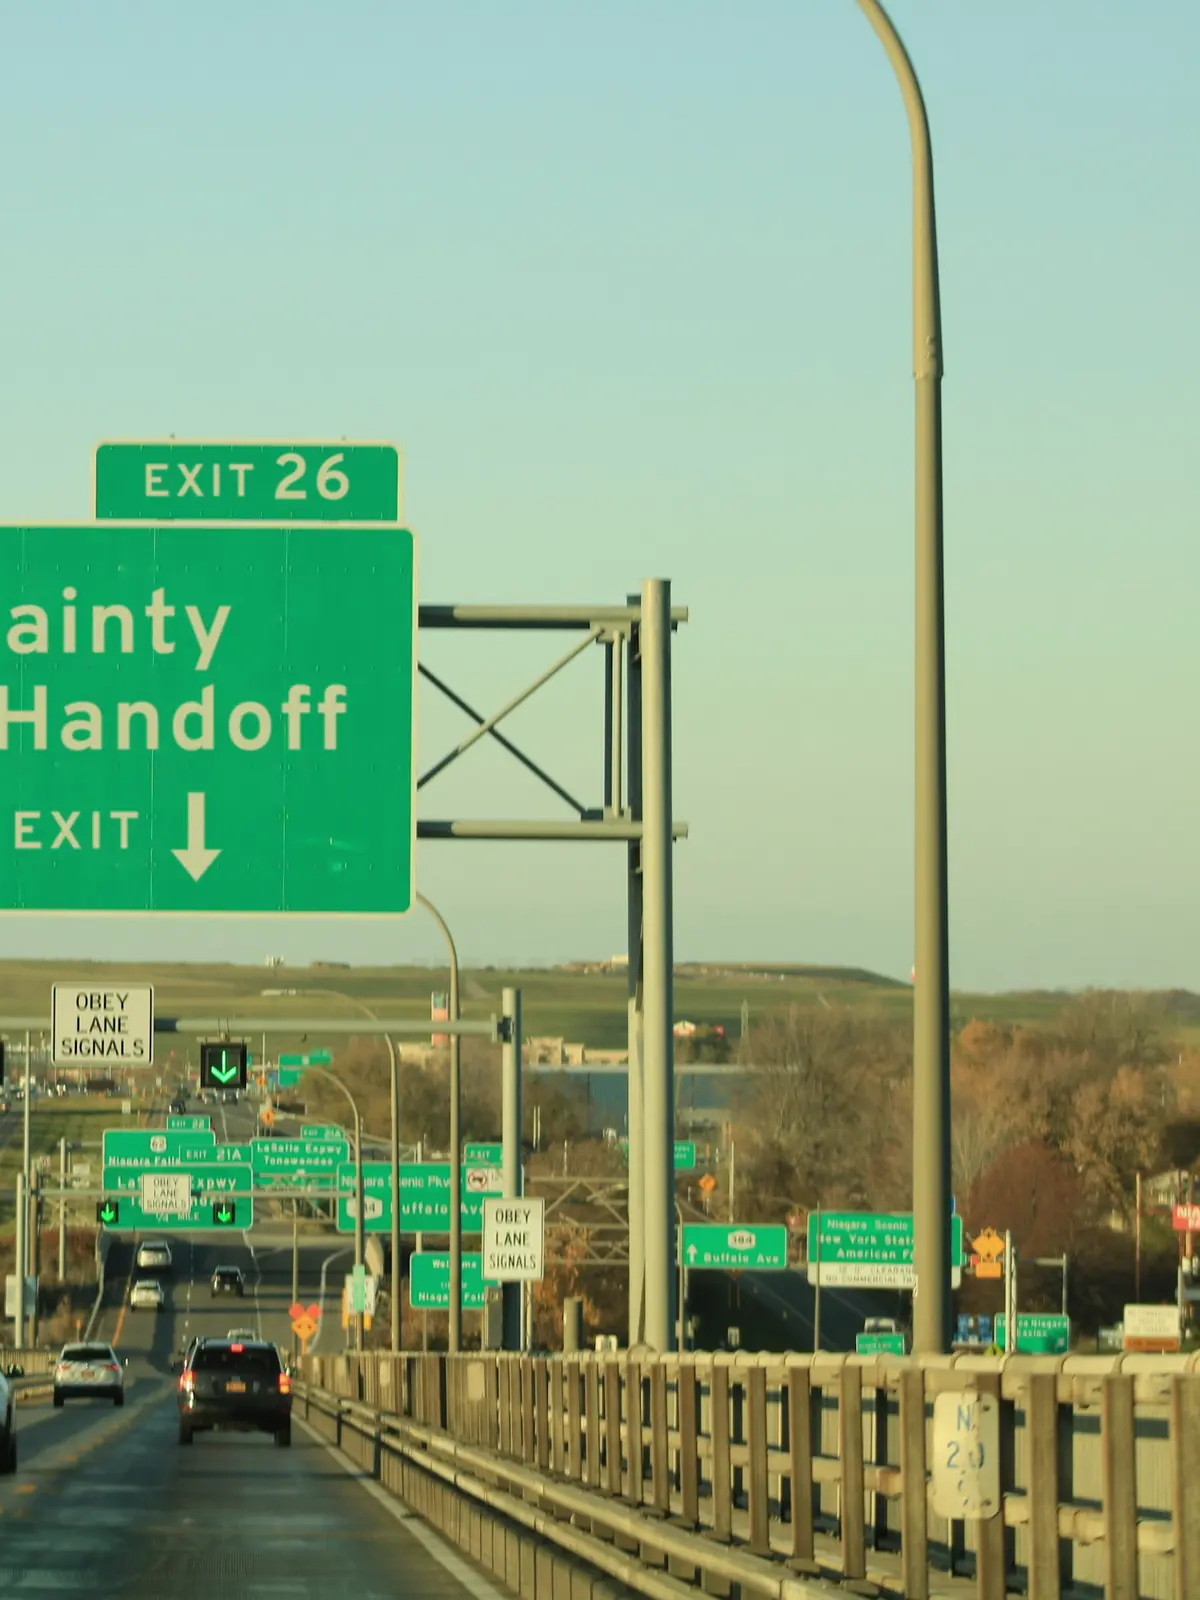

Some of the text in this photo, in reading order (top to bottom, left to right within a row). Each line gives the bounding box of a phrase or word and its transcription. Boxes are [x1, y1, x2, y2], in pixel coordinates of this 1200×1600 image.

[144, 454, 350, 500] EXIT 26
[14, 811, 140, 849] EXIT
[76, 991, 129, 1012] OBEY
[76, 1015, 129, 1034] LANE
[61, 1038, 144, 1058] SIGNALS
[186, 1147, 242, 1161] EXIT 21A
[153, 1176, 179, 1188] OBEY
[153, 1188, 179, 1198] LANE
[146, 1199, 188, 1210] SIGNALS
[390, 1202, 449, 1215] uffalo
[495, 1208, 531, 1225] OBEY
[495, 1231, 531, 1247] LANE
[849, 1233, 877, 1245] York
[432, 1259, 477, 1269] Welme
[489, 1253, 536, 1269] SIGNALS
[703, 1252, 779, 1264] Buffalo Ave
